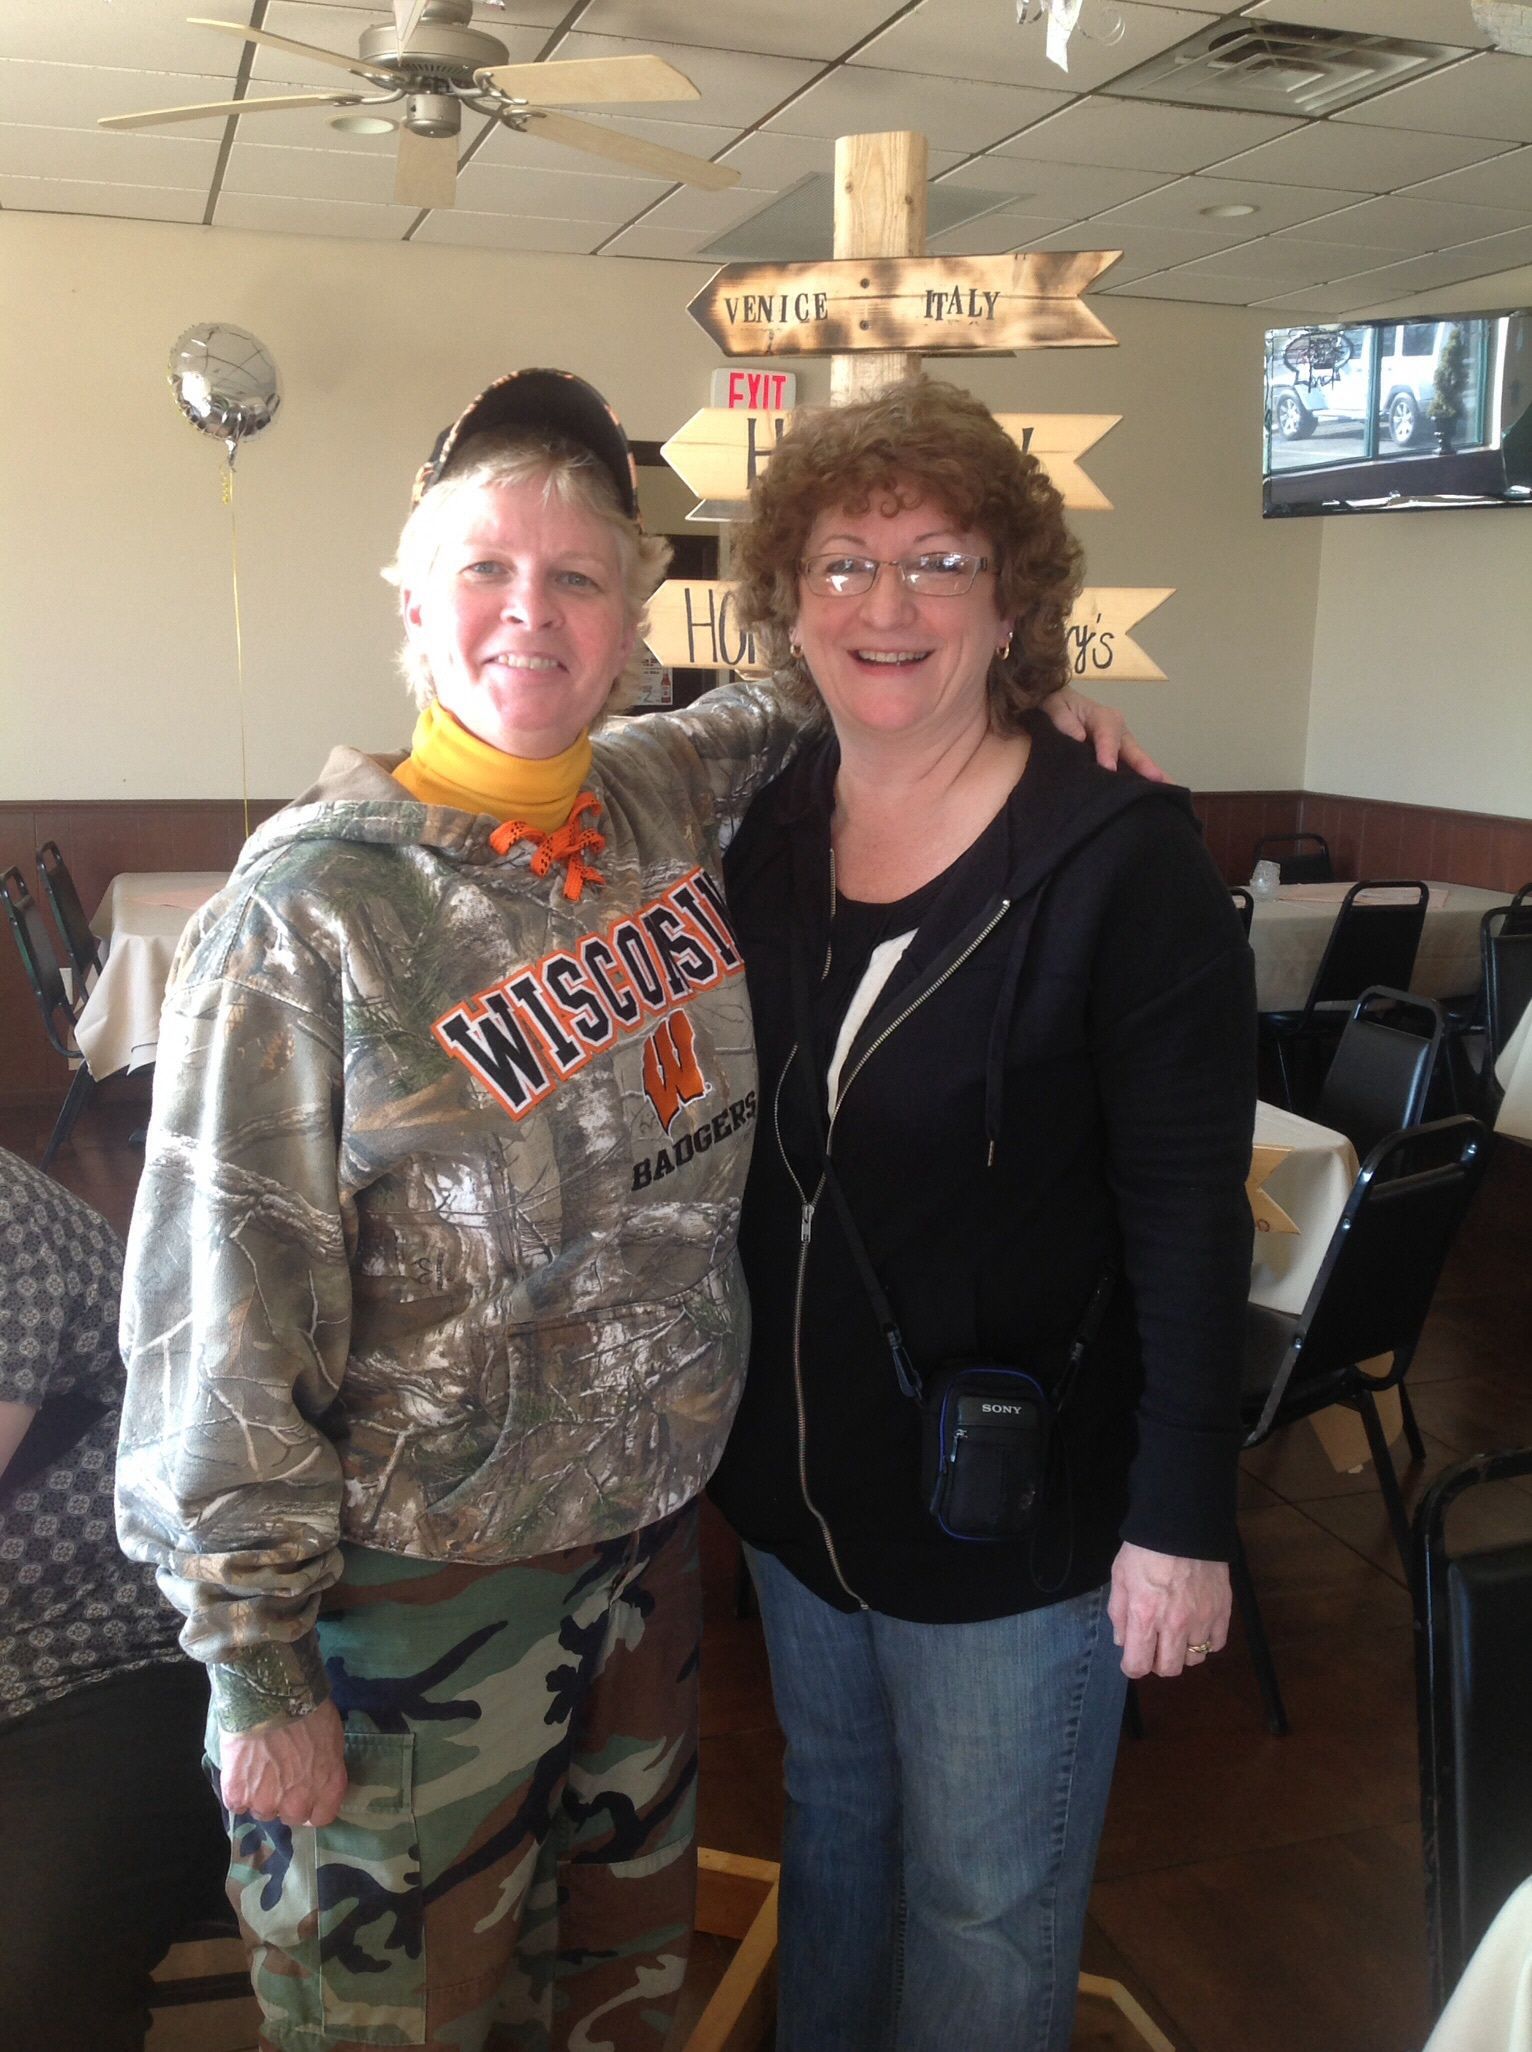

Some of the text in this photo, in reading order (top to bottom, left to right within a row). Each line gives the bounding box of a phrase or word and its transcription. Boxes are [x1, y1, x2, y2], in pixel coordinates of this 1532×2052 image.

[724, 284, 1001, 325] VENICE ITALY
[728, 372, 787, 410] EXIT
[631, 1090, 757, 1192] BADGERS
[981, 1403, 1023, 1415] SONY
